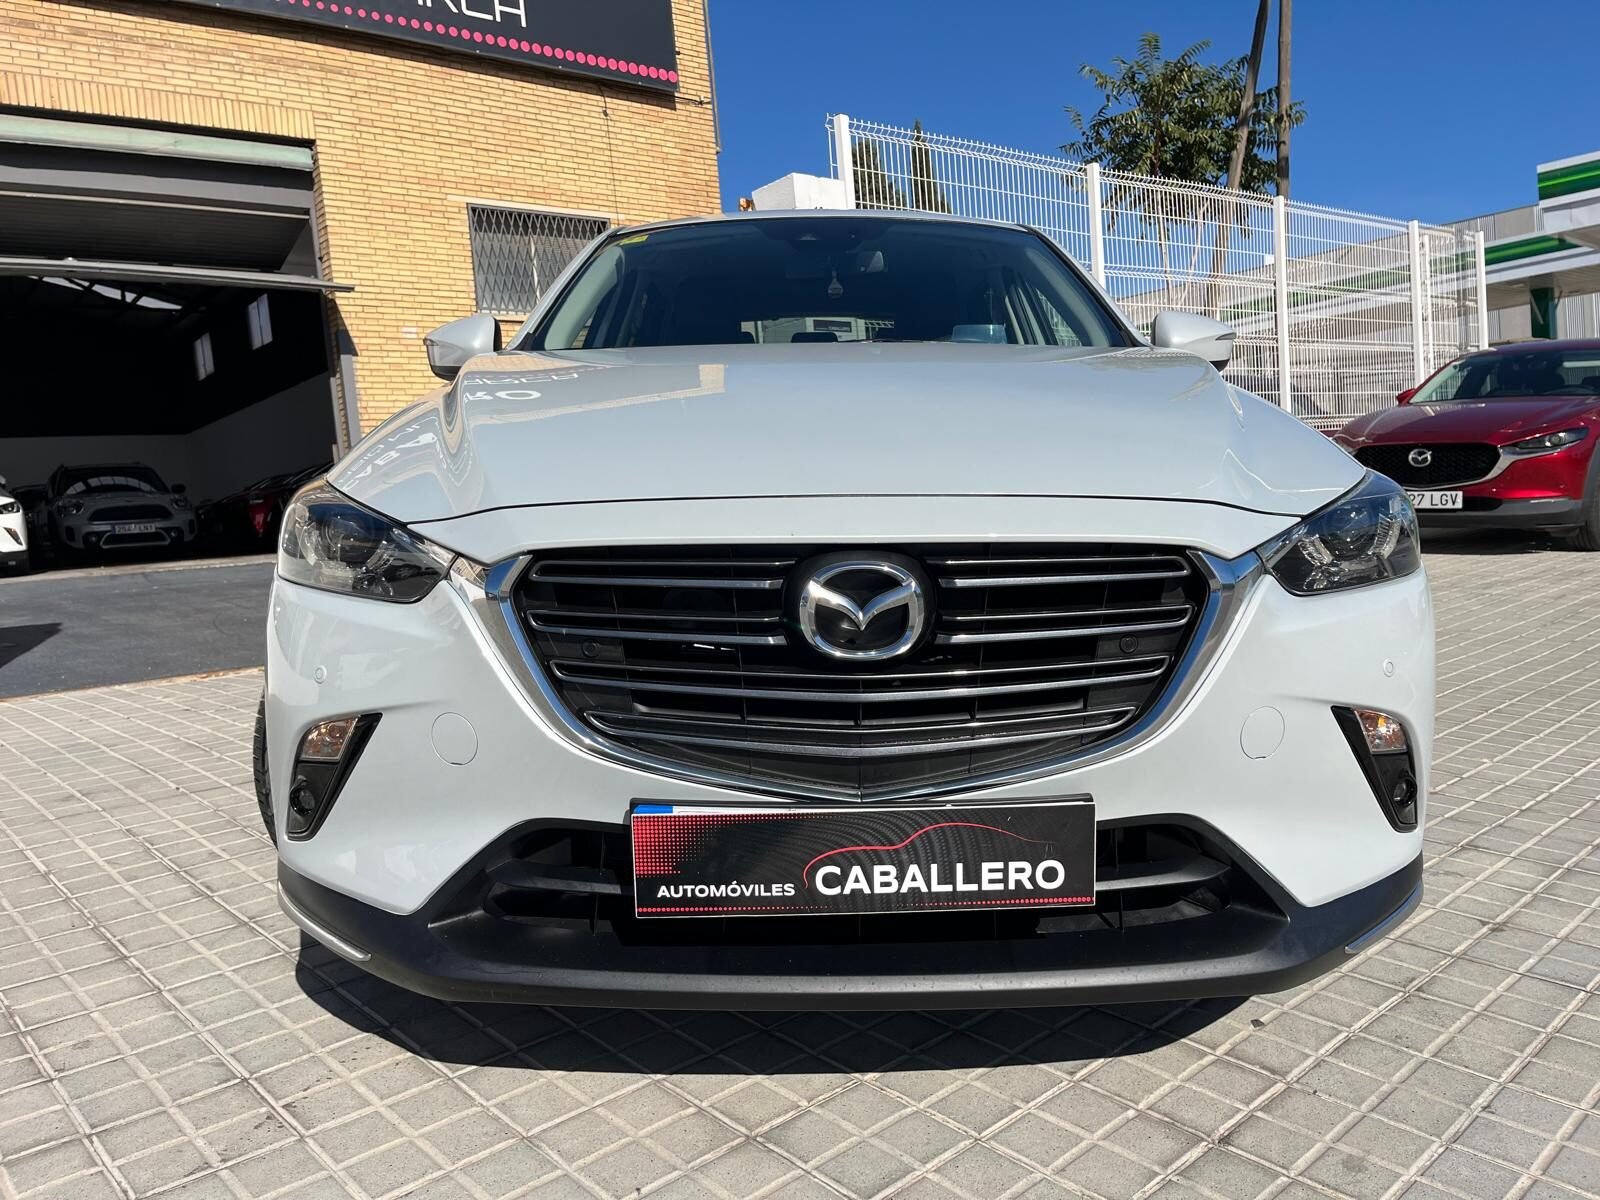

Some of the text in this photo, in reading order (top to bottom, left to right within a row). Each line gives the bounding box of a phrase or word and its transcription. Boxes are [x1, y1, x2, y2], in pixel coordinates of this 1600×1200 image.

[1430, 493, 1458, 507] LGV
[657, 859, 1066, 898] AUTOMÓVILES CABALLERO
